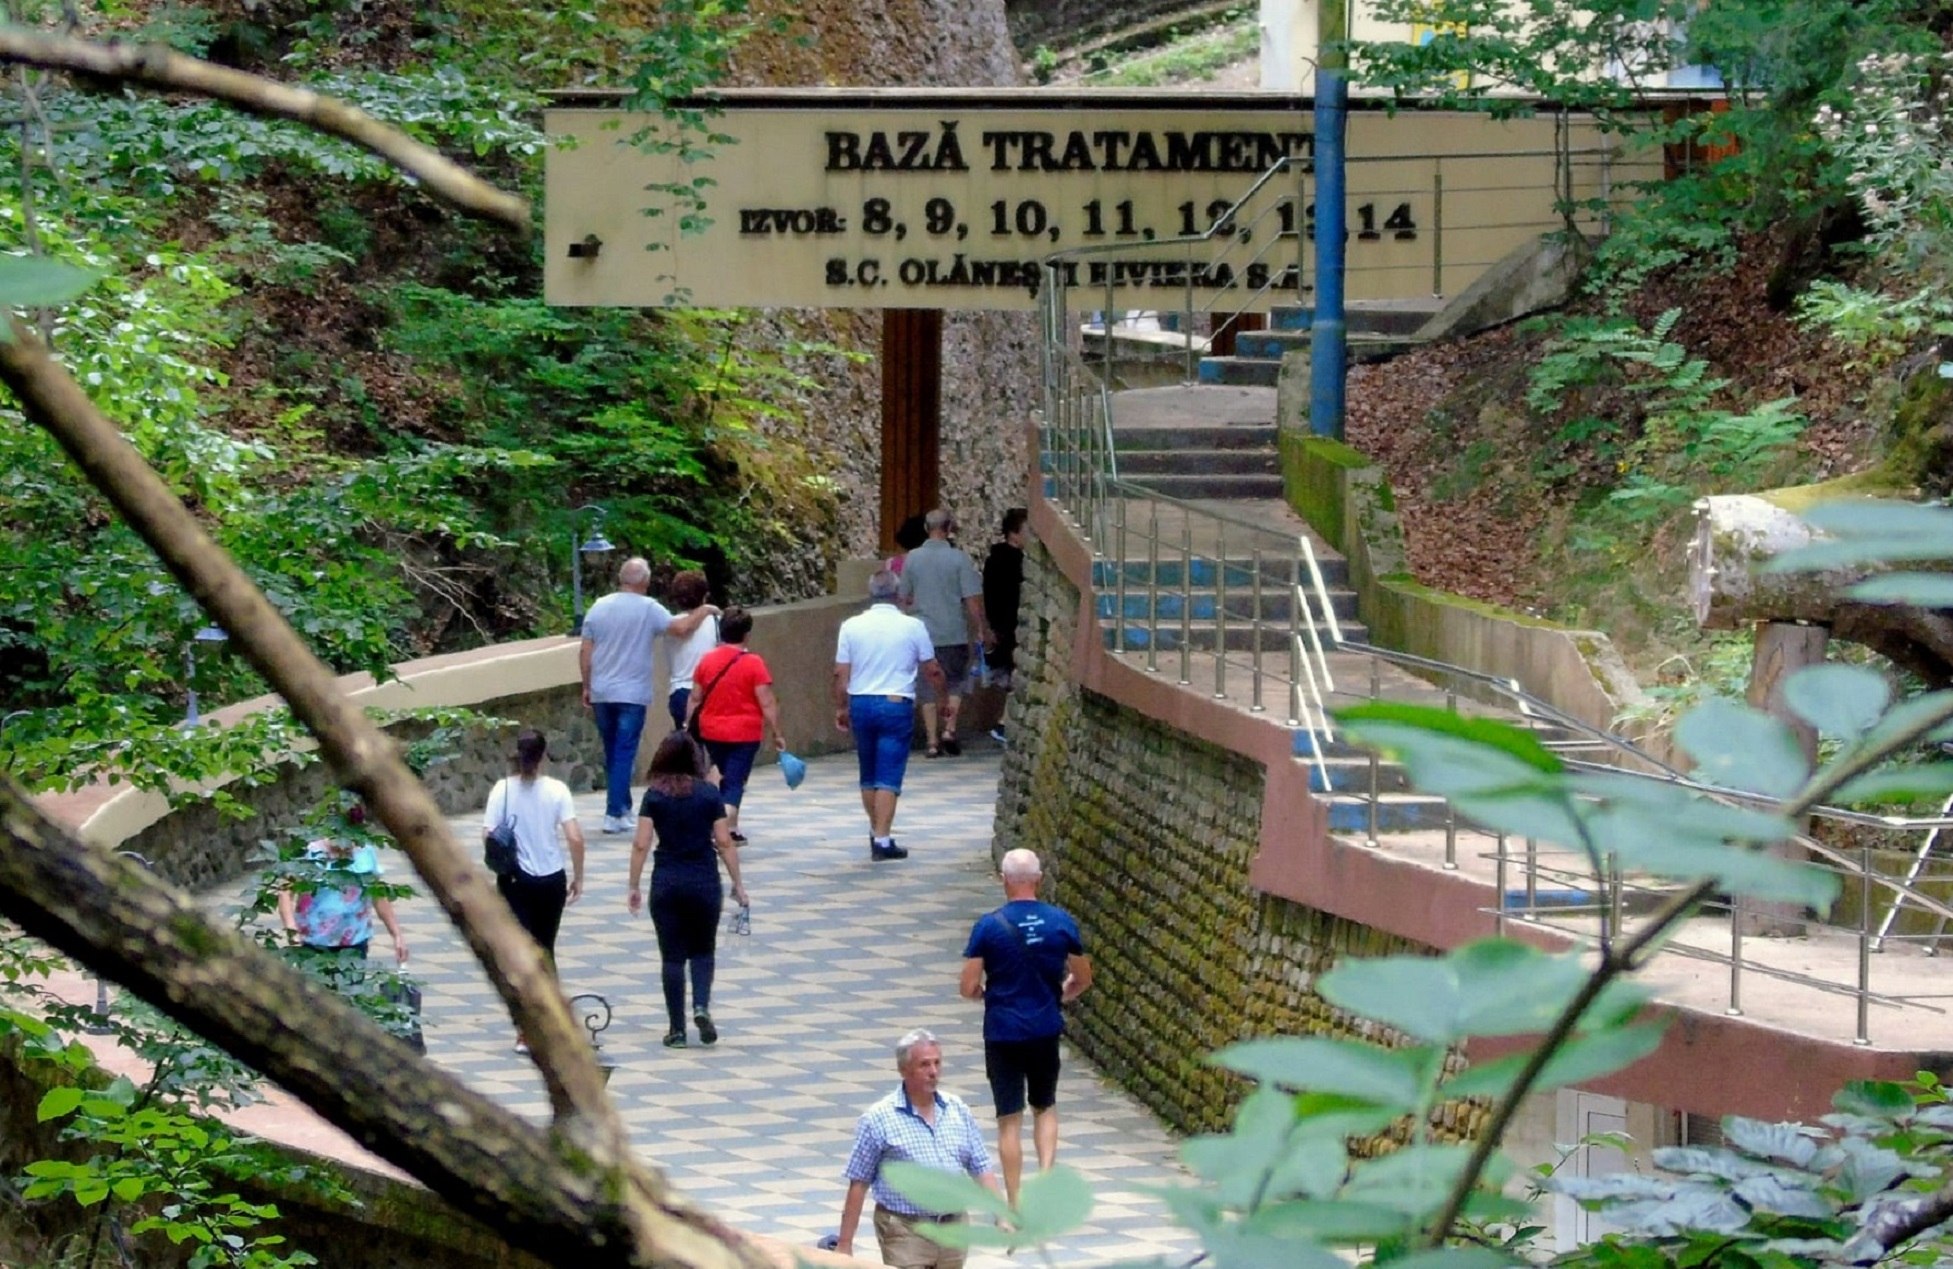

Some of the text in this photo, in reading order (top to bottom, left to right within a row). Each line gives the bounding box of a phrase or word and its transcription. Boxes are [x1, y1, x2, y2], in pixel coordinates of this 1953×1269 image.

[825, 120, 969, 171] BAZĂ
[862, 198, 907, 240] 8,
[925, 198, 968, 240] 9,
[991, 200, 1060, 242] 10,
[1082, 199, 1155, 241] 11,
[1178, 201, 1252, 244] 12,
[1358, 203, 1417, 240] 14
[826, 258, 888, 286] S.C.
[901, 254, 1079, 299] OLĂNEȘI
